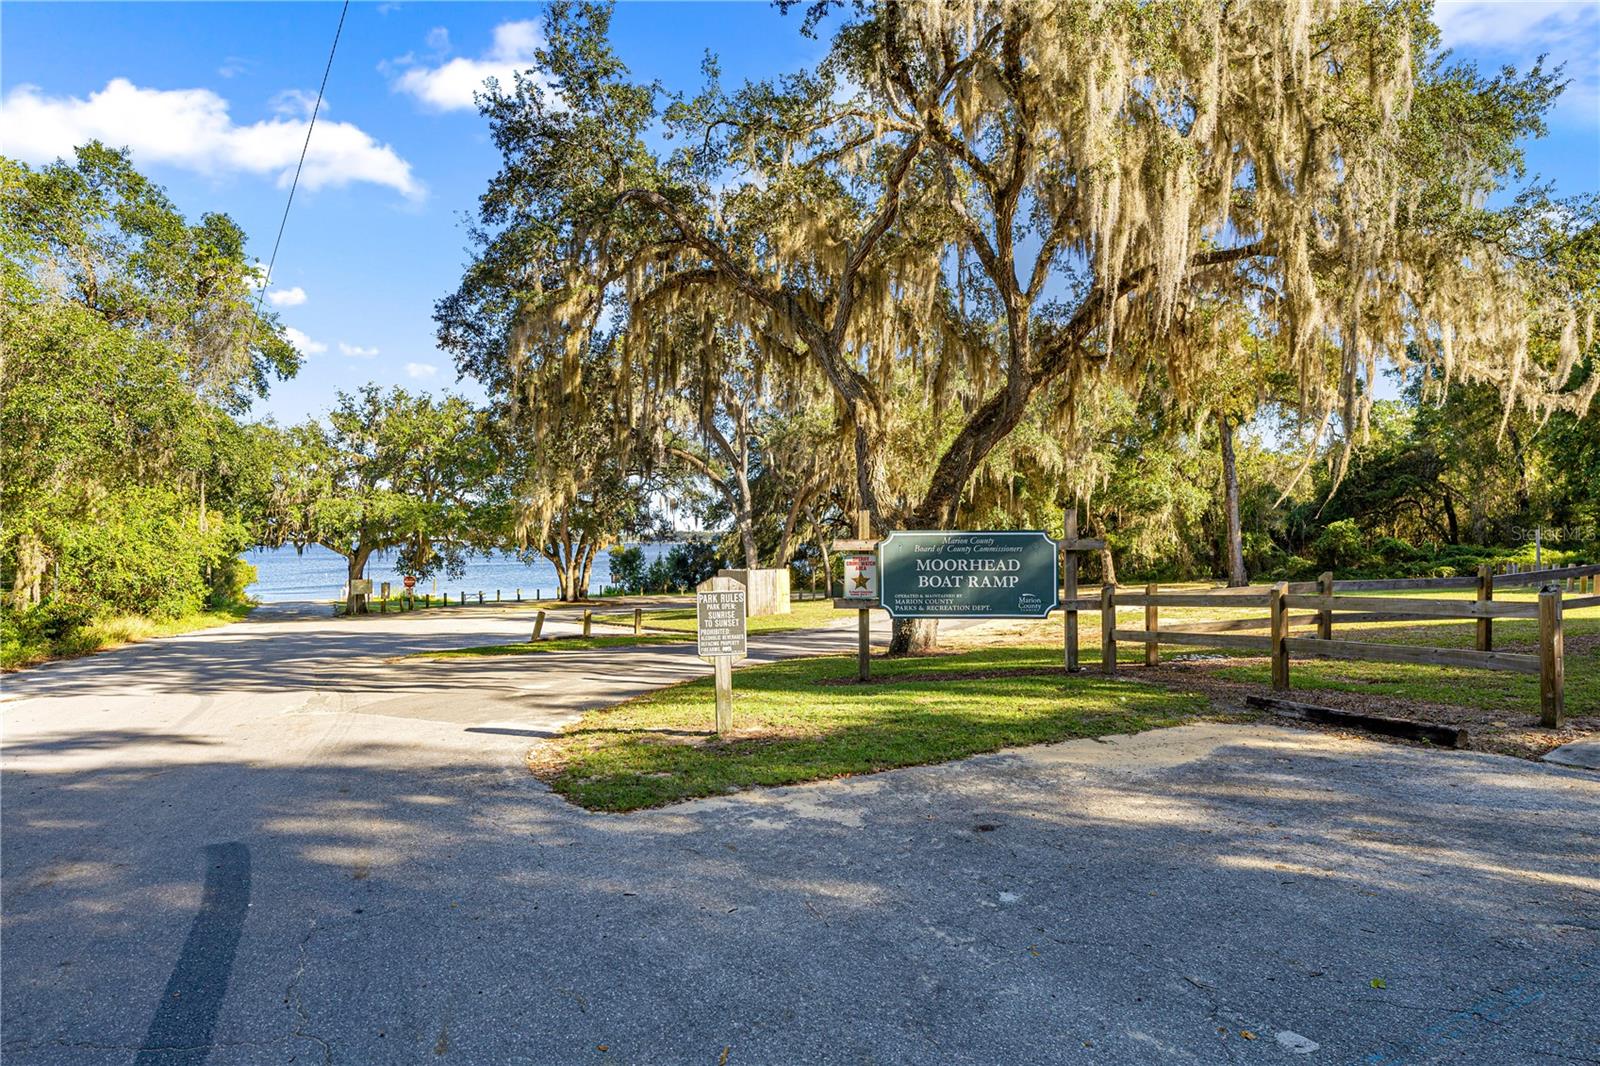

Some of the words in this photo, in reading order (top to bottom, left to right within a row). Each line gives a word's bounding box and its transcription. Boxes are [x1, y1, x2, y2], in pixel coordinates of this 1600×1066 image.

[970, 536, 994, 546] County
[914, 544, 936, 552] Board
[936, 544, 944, 554] of
[946, 544, 972, 554] County
[916, 558, 1020, 572] MOORHEAD
[918, 576, 964, 588] BOAT
[968, 576, 1019, 588] RAMP
[700, 594, 718, 604] PARK
[720, 593, 744, 603] RULES
[715, 619, 739, 627] SUNSET
